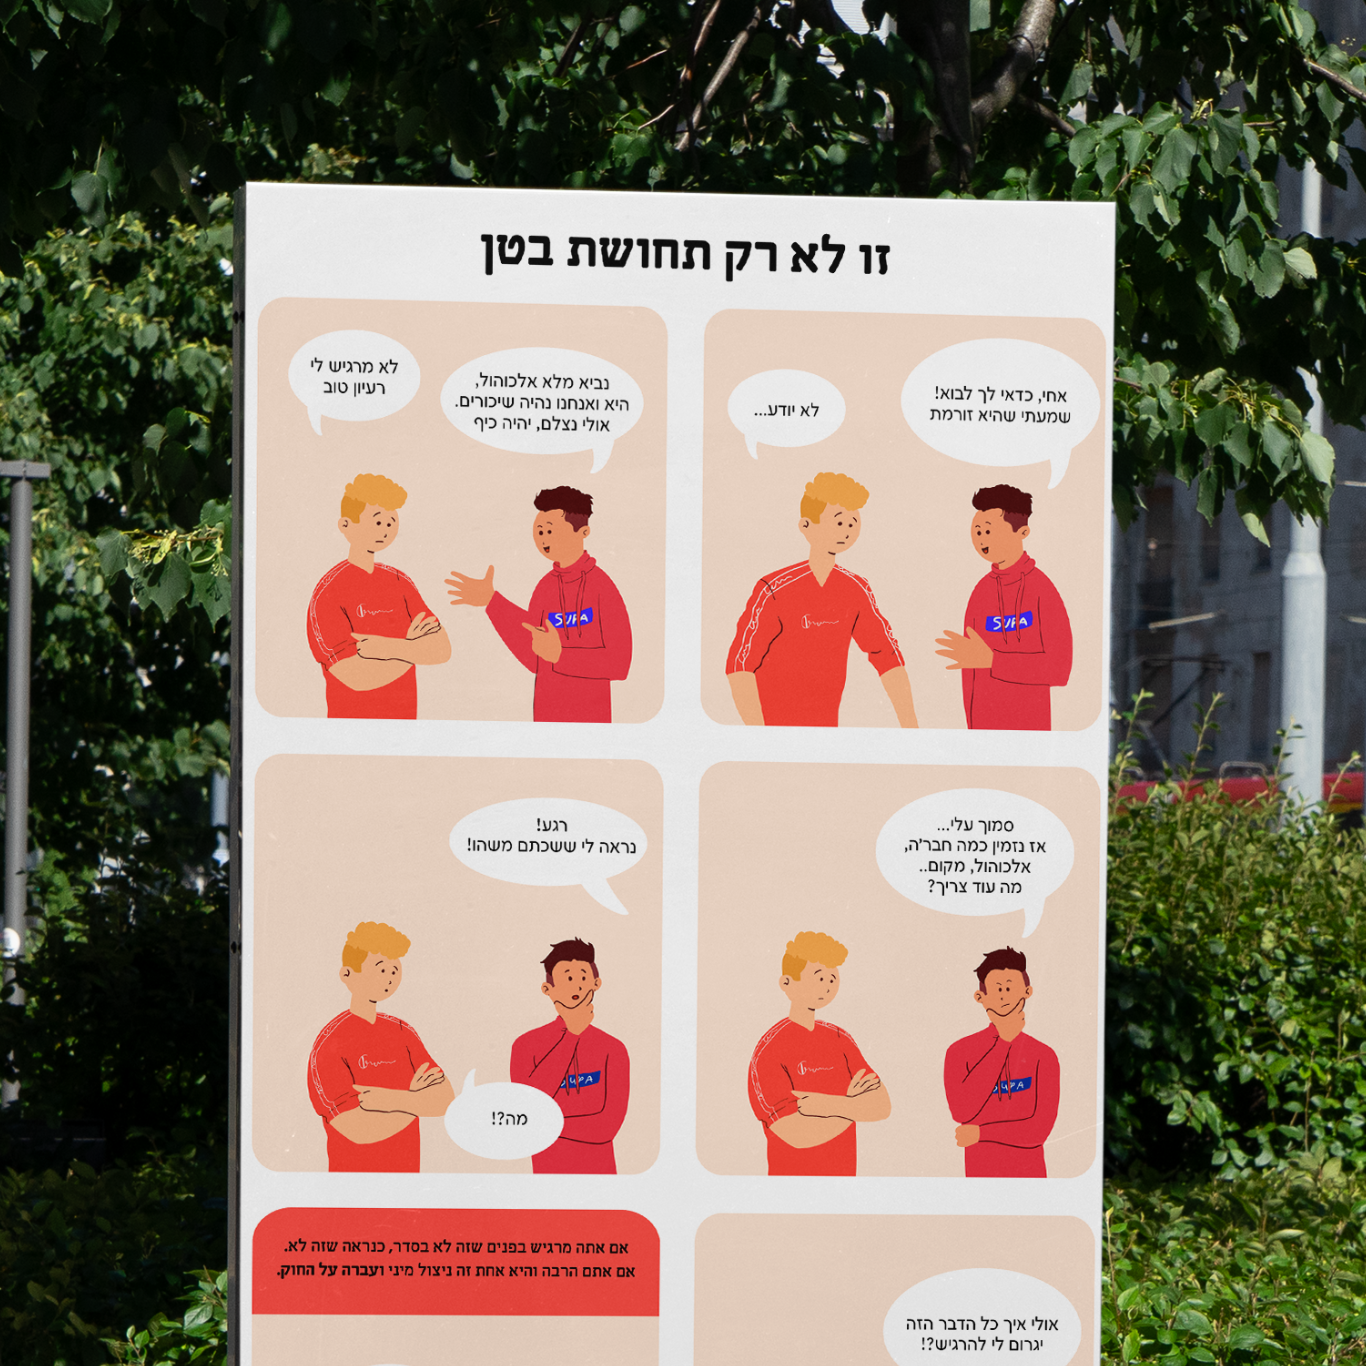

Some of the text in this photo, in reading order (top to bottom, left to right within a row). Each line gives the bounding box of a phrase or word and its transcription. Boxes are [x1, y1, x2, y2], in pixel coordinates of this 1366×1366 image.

[480, 233, 890, 280] זו לא רק תחושת בטן
[310, 357, 398, 373] לא מרגיש לי
[323, 381, 385, 397] רעיון טוב
[935, 385, 1066, 404] אחי, כדאי לך לבוא!
[754, 402, 819, 417] לא יודע...
[929, 408, 1070, 423] שמעתי שהיא זורמת
[536, 817, 567, 832] רגע!
[937, 816, 1014, 835] סמוך עלי...
[467, 837, 636, 854] נראה לי ששכתם משהו!
[957, 840, 987, 852] כמה
[992, 840, 1024, 855] נזמין
[1029, 841, 1046, 853] אז
[970, 858, 1030, 874] אלכוהול,
[927, 878, 1021, 896] מה עוד צריך?
[492, 1111, 527, 1125] מה?!
[906, 1315, 1058, 1334] אולי איך כל הדבר הזה
